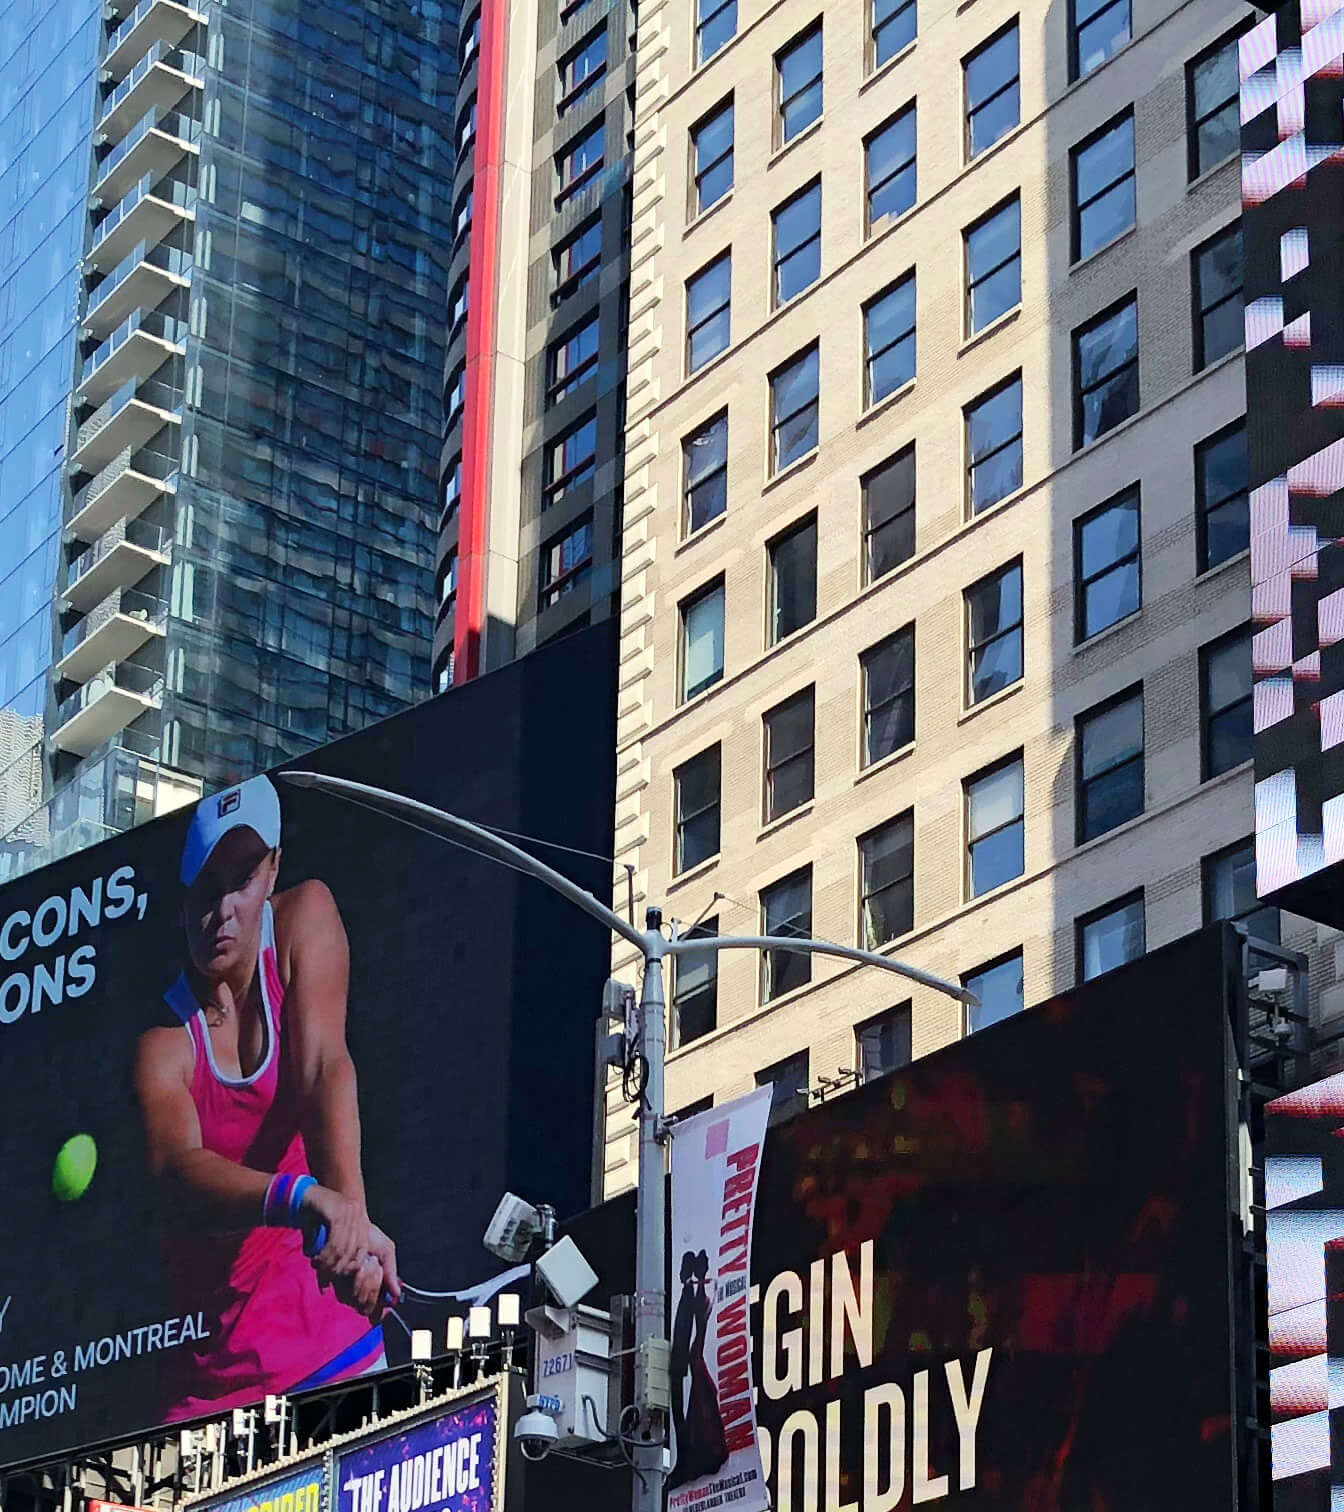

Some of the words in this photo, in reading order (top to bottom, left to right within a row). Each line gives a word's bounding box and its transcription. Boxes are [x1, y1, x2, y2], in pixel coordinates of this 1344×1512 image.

[718, 1143, 760, 1277] PRETTY
[51, 1351, 66, 1378] &
[74, 1311, 210, 1372] MONTREAL
[714, 1295, 755, 1453] WOMAN
